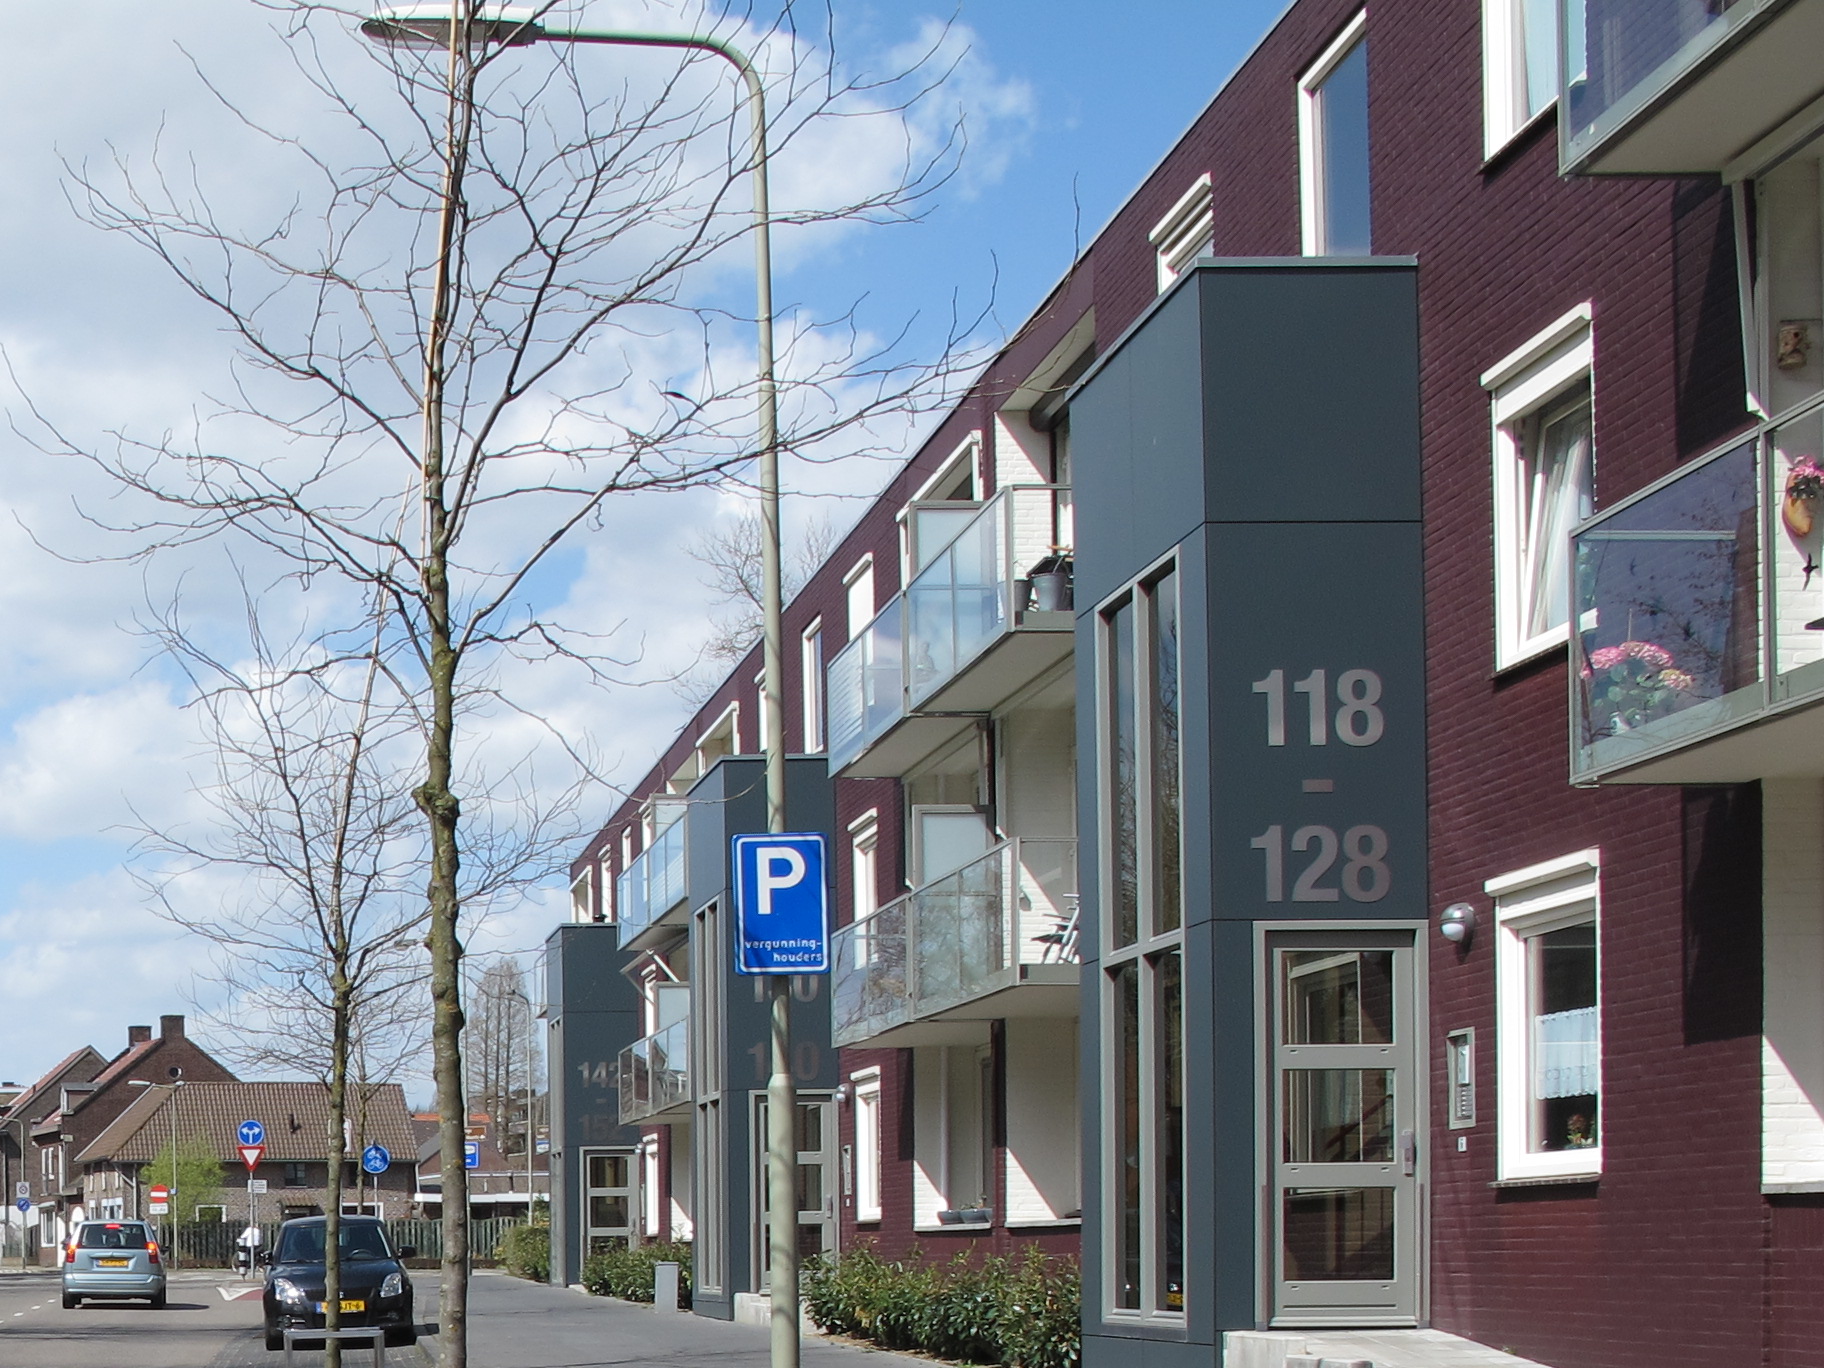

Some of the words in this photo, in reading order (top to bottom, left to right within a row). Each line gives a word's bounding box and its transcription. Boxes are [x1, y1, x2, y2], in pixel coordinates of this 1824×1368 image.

[1252, 669, 1385, 747] 118
[756, 846, 806, 915] P
[1250, 825, 1392, 903] 128
[744, 938, 822, 951] vergunning-
[773, 951, 823, 962] houders
[747, 1041, 821, 1082] 10
